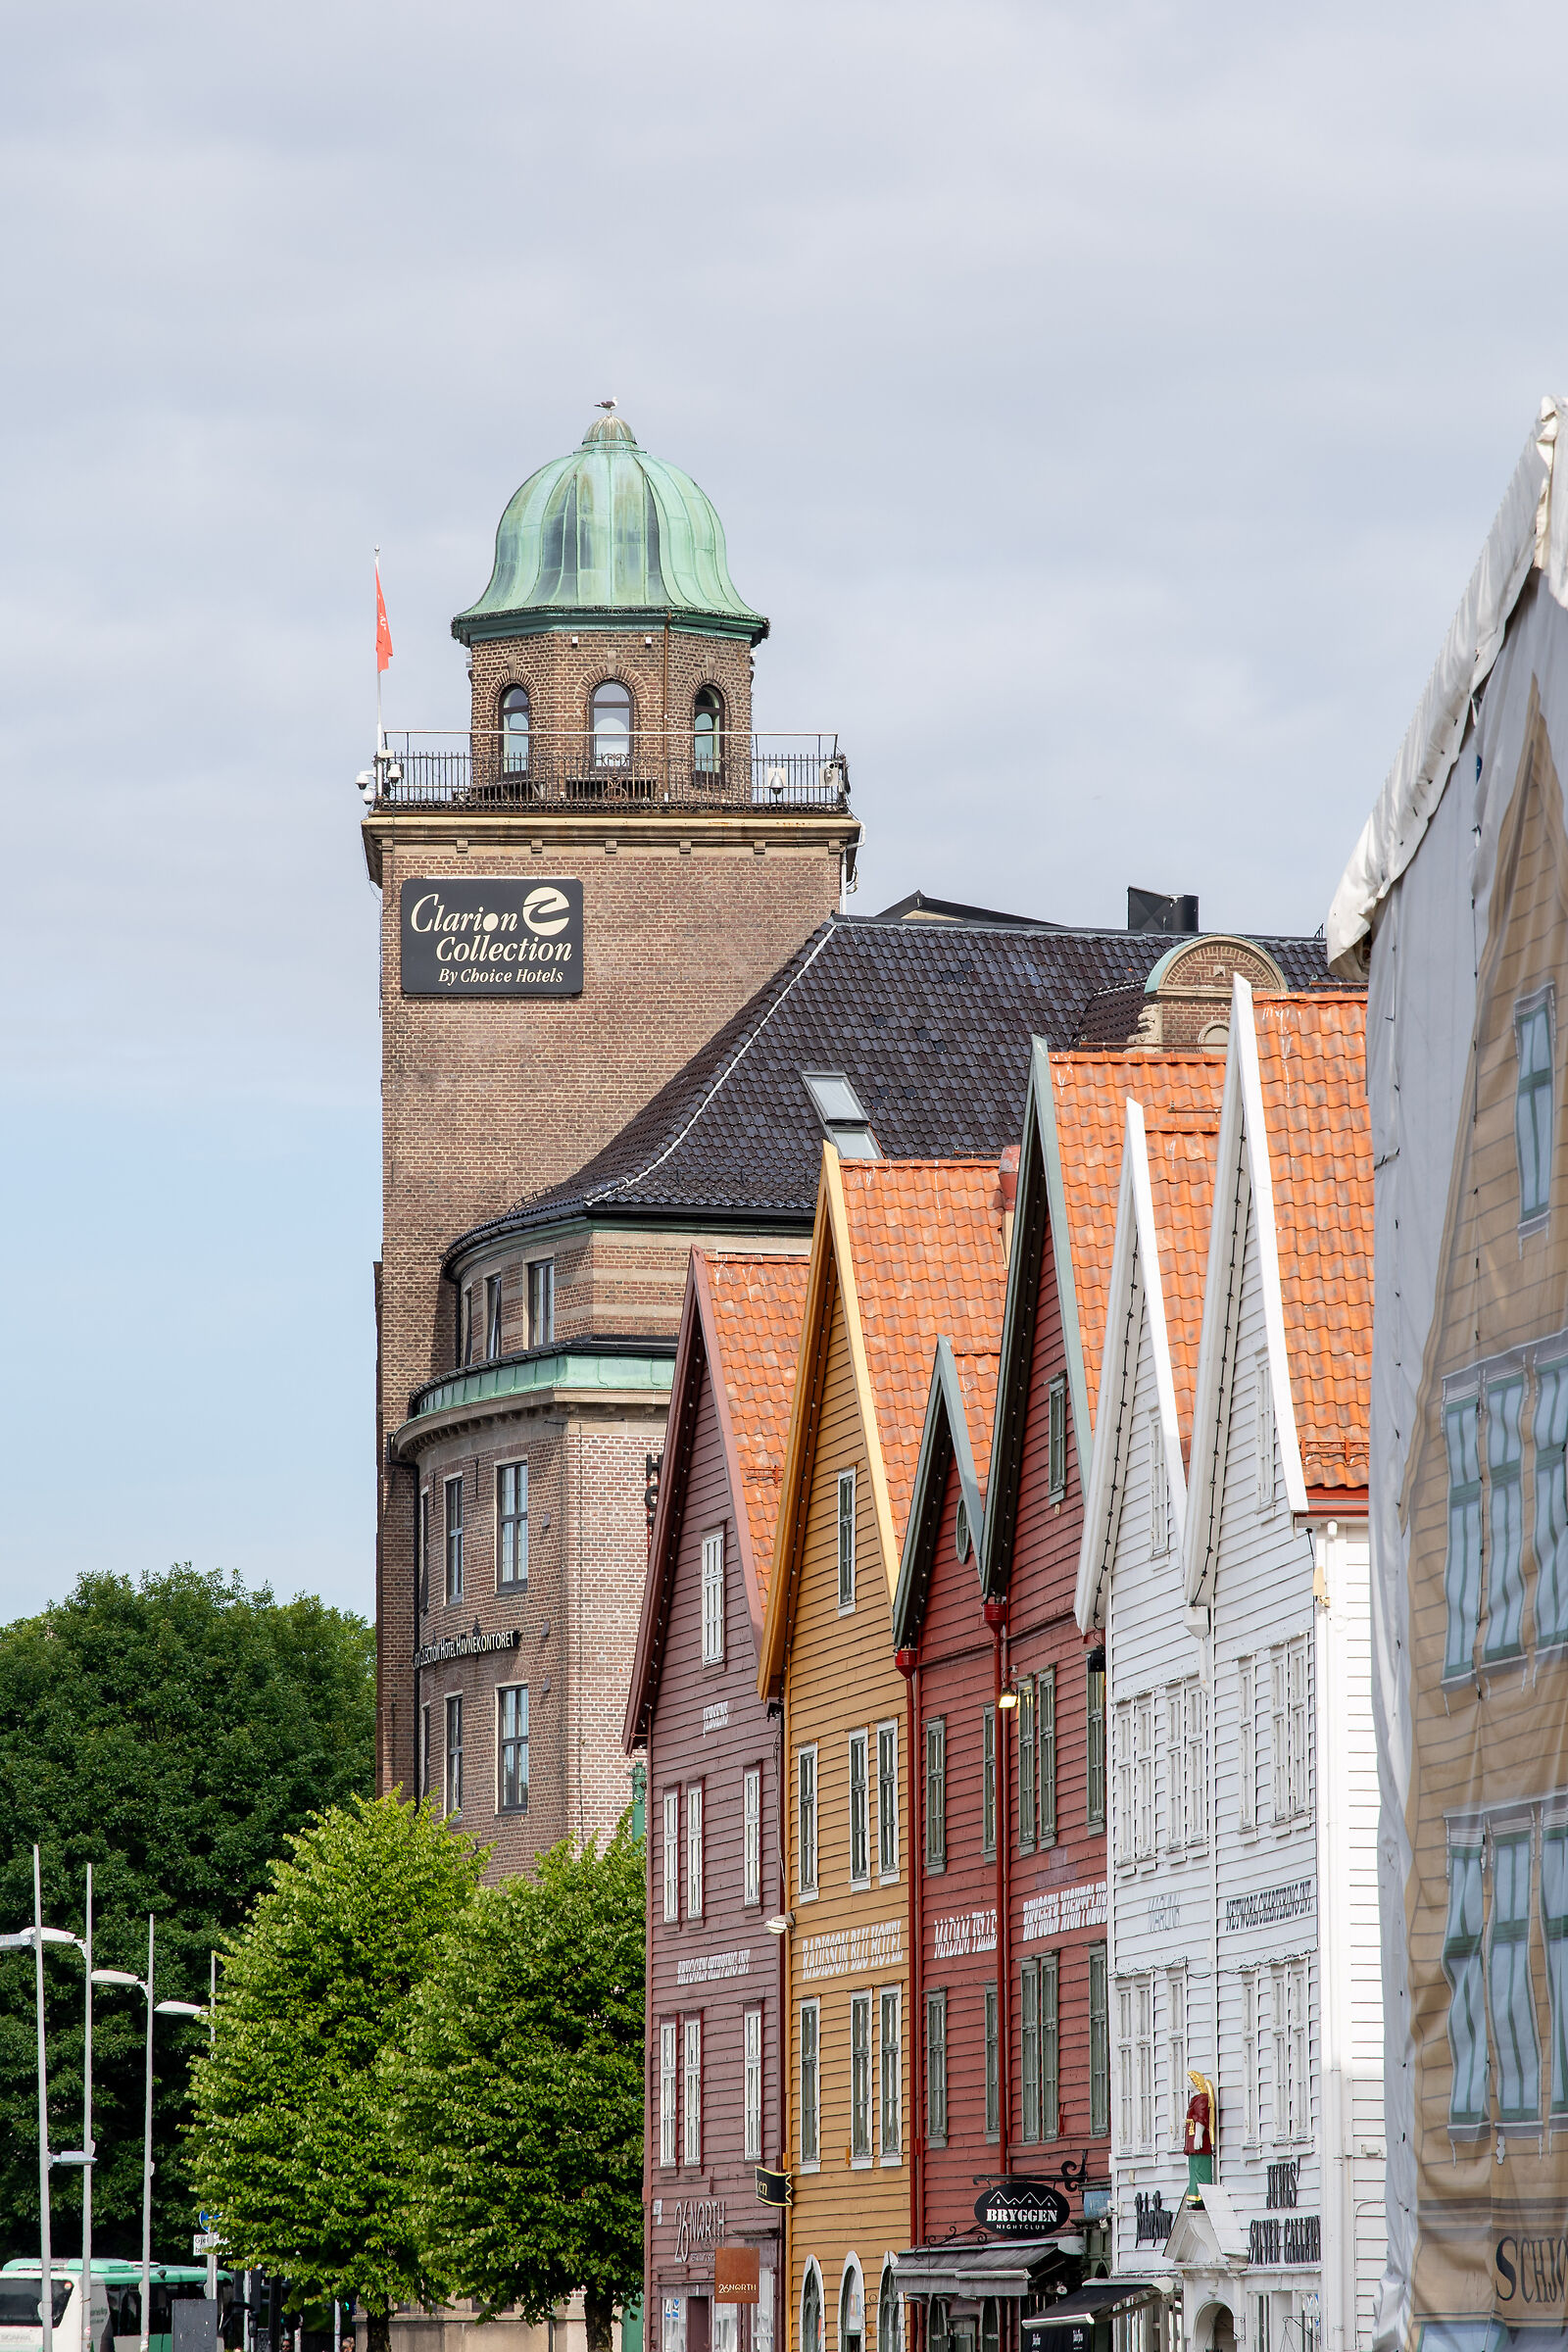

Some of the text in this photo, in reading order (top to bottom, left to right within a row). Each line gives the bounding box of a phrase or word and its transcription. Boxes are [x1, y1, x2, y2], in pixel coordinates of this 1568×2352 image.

[411, 893, 518, 932] Clarion
[436, 934, 572, 961] Collection
[438, 967, 564, 986] By Choice Hotels
[456, 1630, 514, 1656] HAVNEKONTORET
[1023, 1892, 1059, 1941] BRYGGEN
[803, 1921, 904, 1980] RADISSON BLU HOTEL
[934, 1914, 970, 1959] MADAM
[986, 2208, 1058, 2223] BRYGGEN
